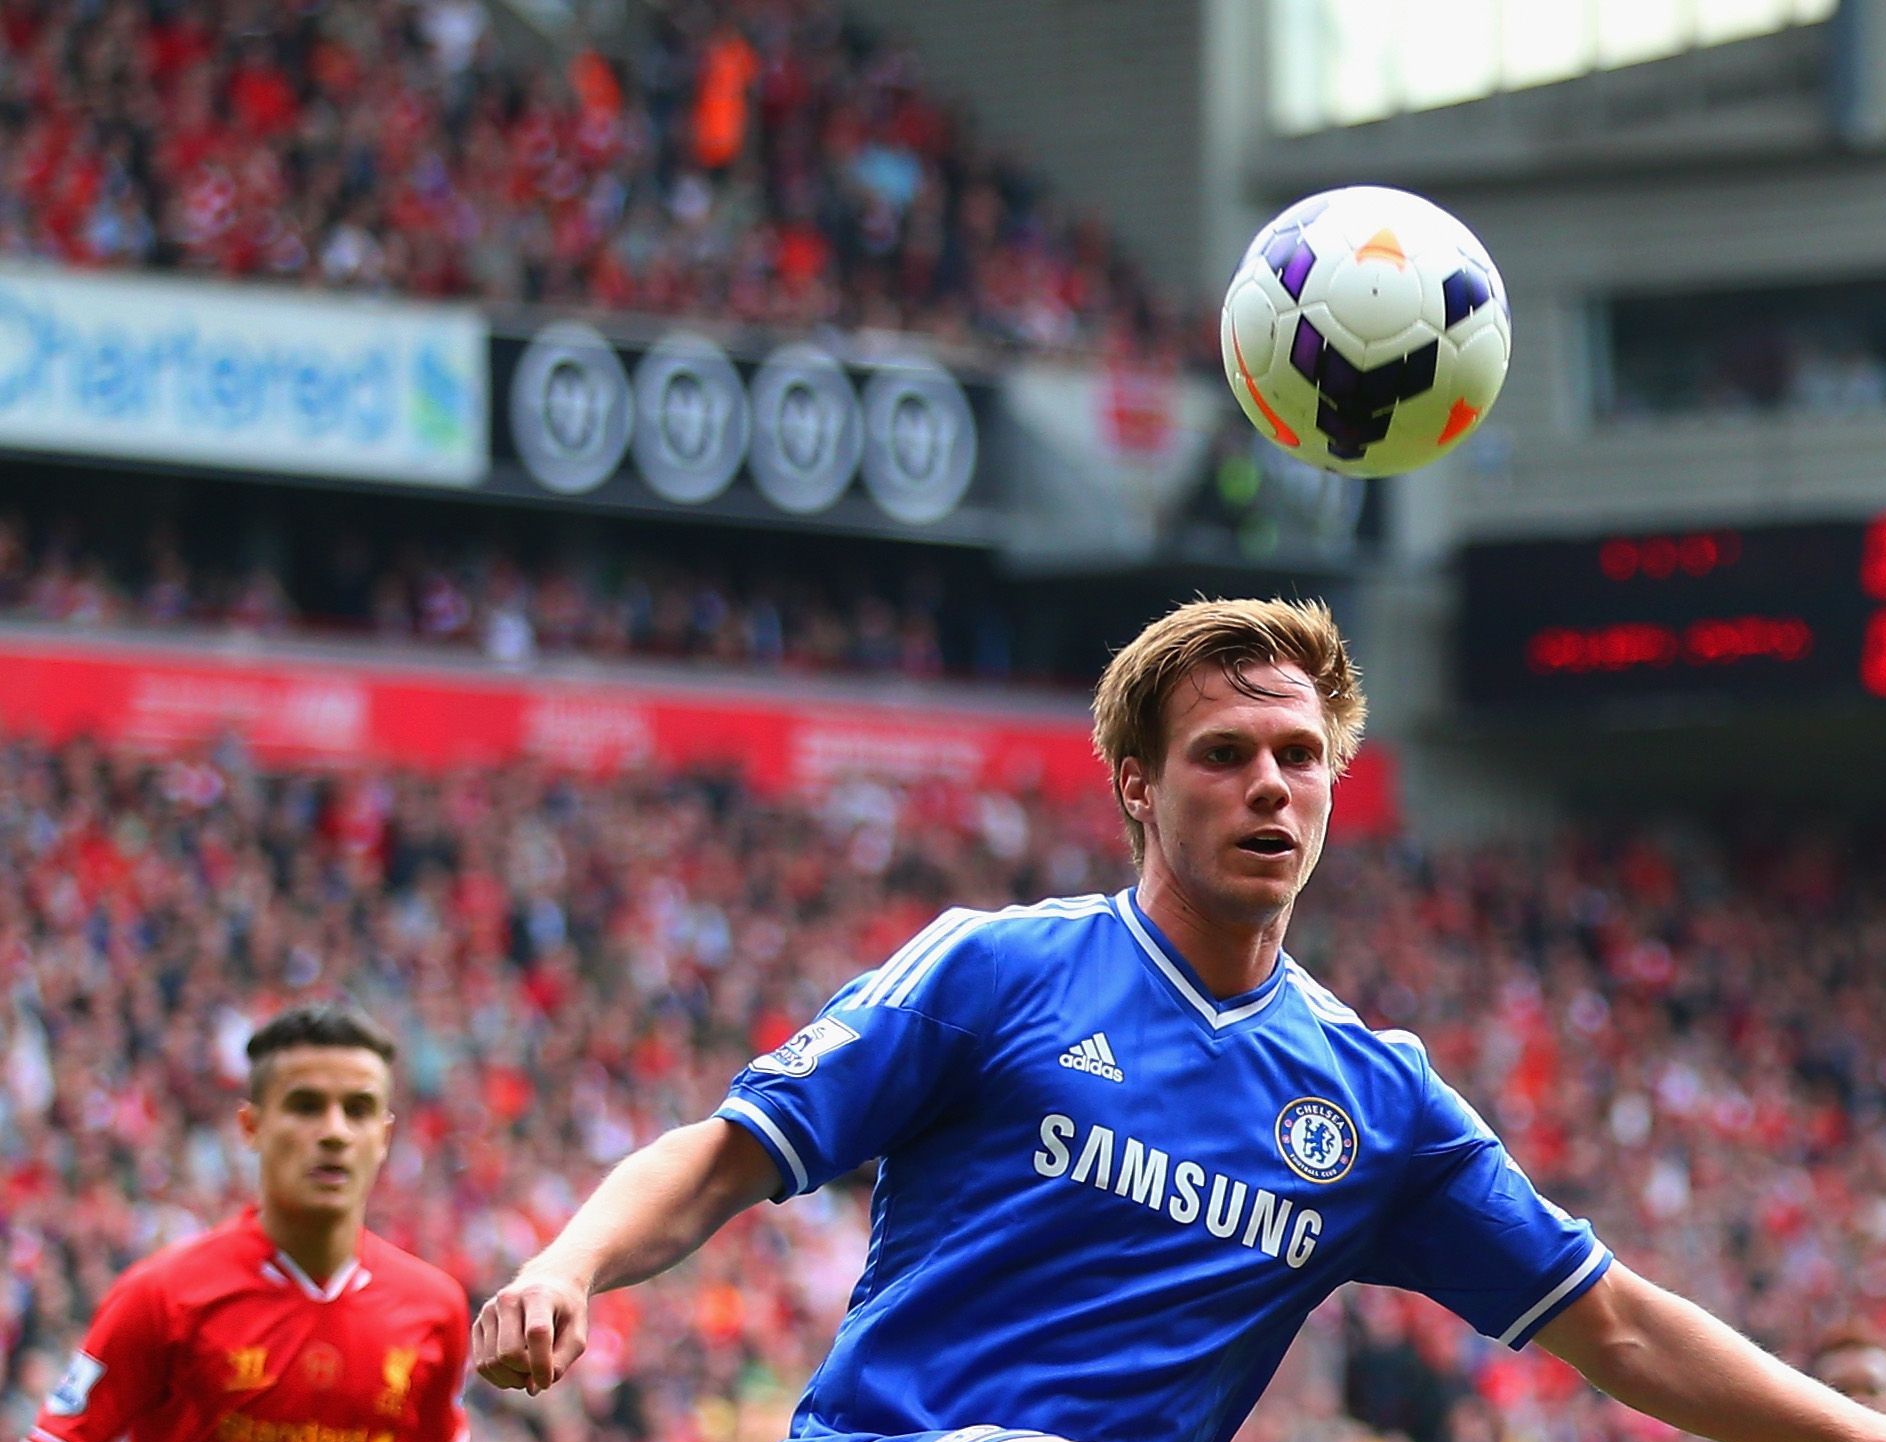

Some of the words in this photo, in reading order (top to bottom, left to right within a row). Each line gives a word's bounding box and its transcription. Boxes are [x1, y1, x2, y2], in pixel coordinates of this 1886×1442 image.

[1059, 1054, 1124, 1083] adidas
[1295, 1104, 1345, 1130] CHELSEA
[1033, 1113, 1323, 1270] SAMSUNG
